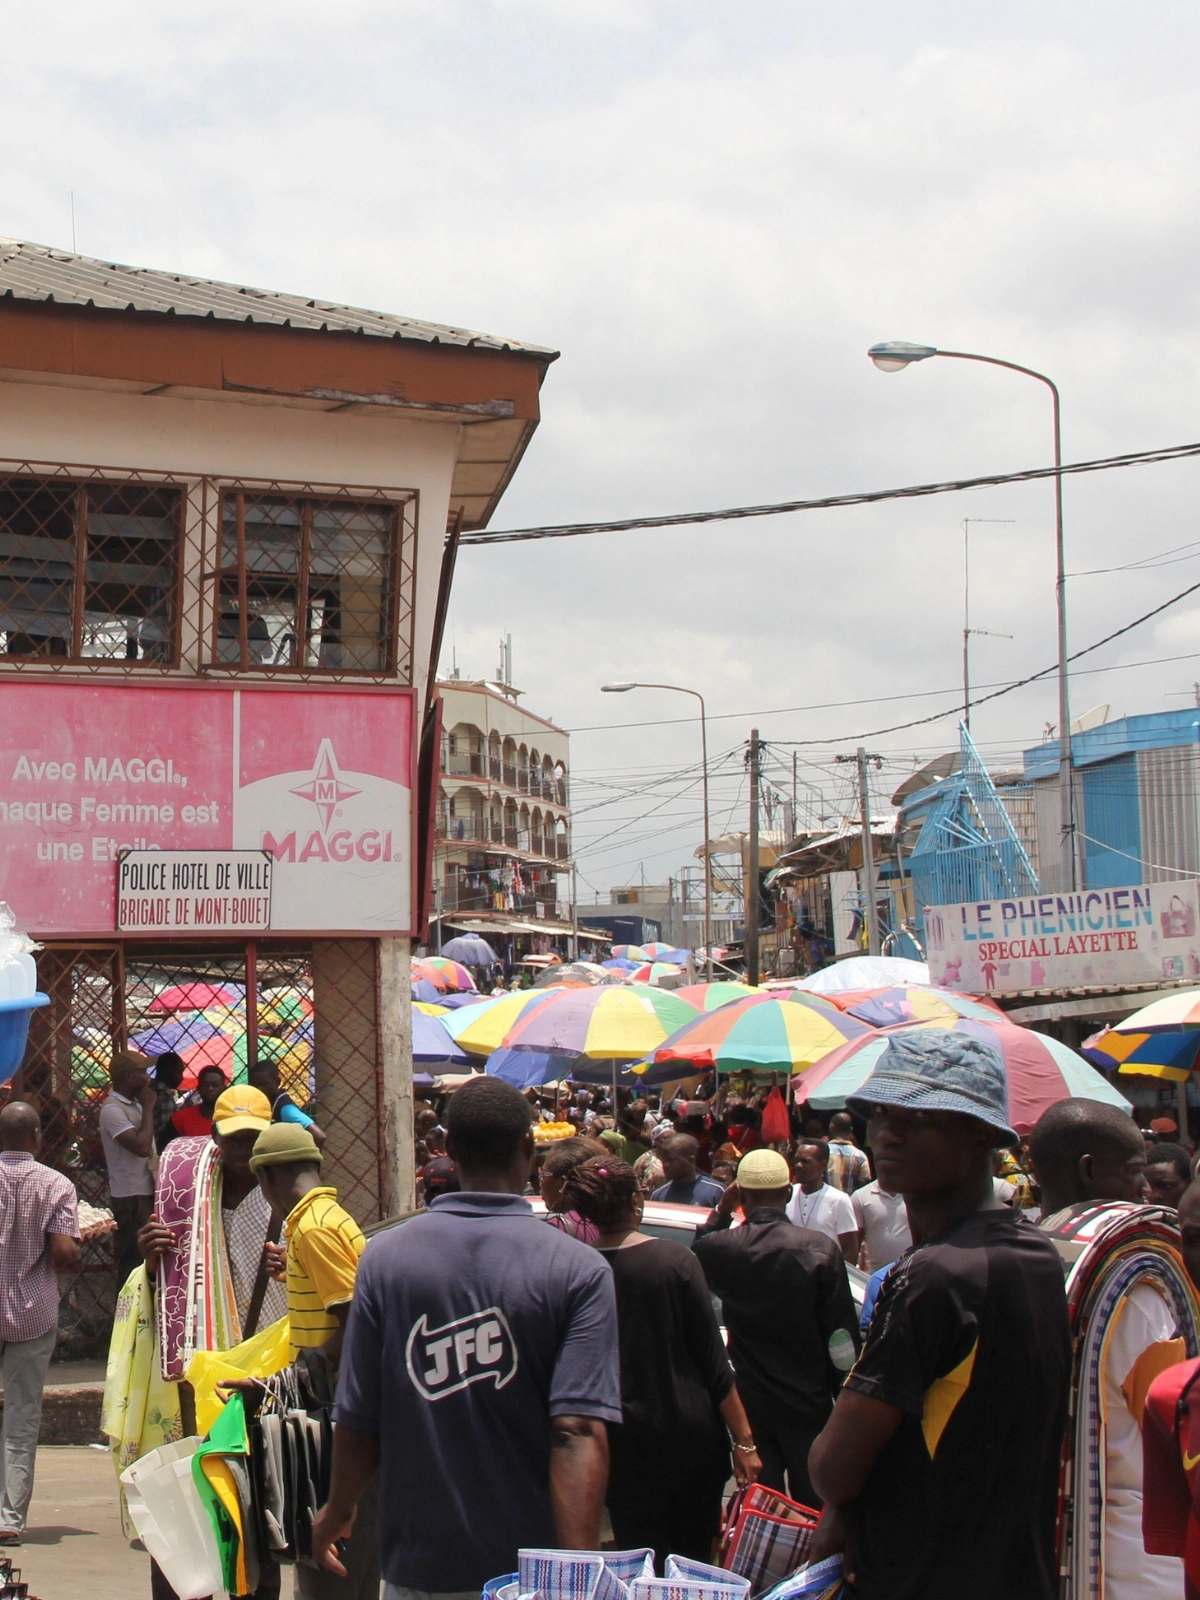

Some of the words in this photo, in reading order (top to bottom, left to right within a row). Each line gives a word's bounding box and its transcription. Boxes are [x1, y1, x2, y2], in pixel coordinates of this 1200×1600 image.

[13, 756, 75, 781] Avec
[80, 798, 174, 823] Femme
[181, 801, 219, 824] est
[37, 840, 84, 861] une
[121, 863, 166, 890] POLICE
[172, 863, 210, 890] HOTEL
[216, 863, 231, 890] DE
[237, 863, 269, 890] VILLE
[120, 898, 171, 926] BRIGADE
[175, 897, 190, 925] DE
[194, 896, 269, 925] MONT-BOUET
[961, 904, 994, 941] LE
[1001, 888, 1153, 937] PHENICIEN
[978, 938, 1051, 961] SPECIAL
[1055, 931, 1138, 956] LAYETTE
[424, 1321, 502, 1385] JFC
